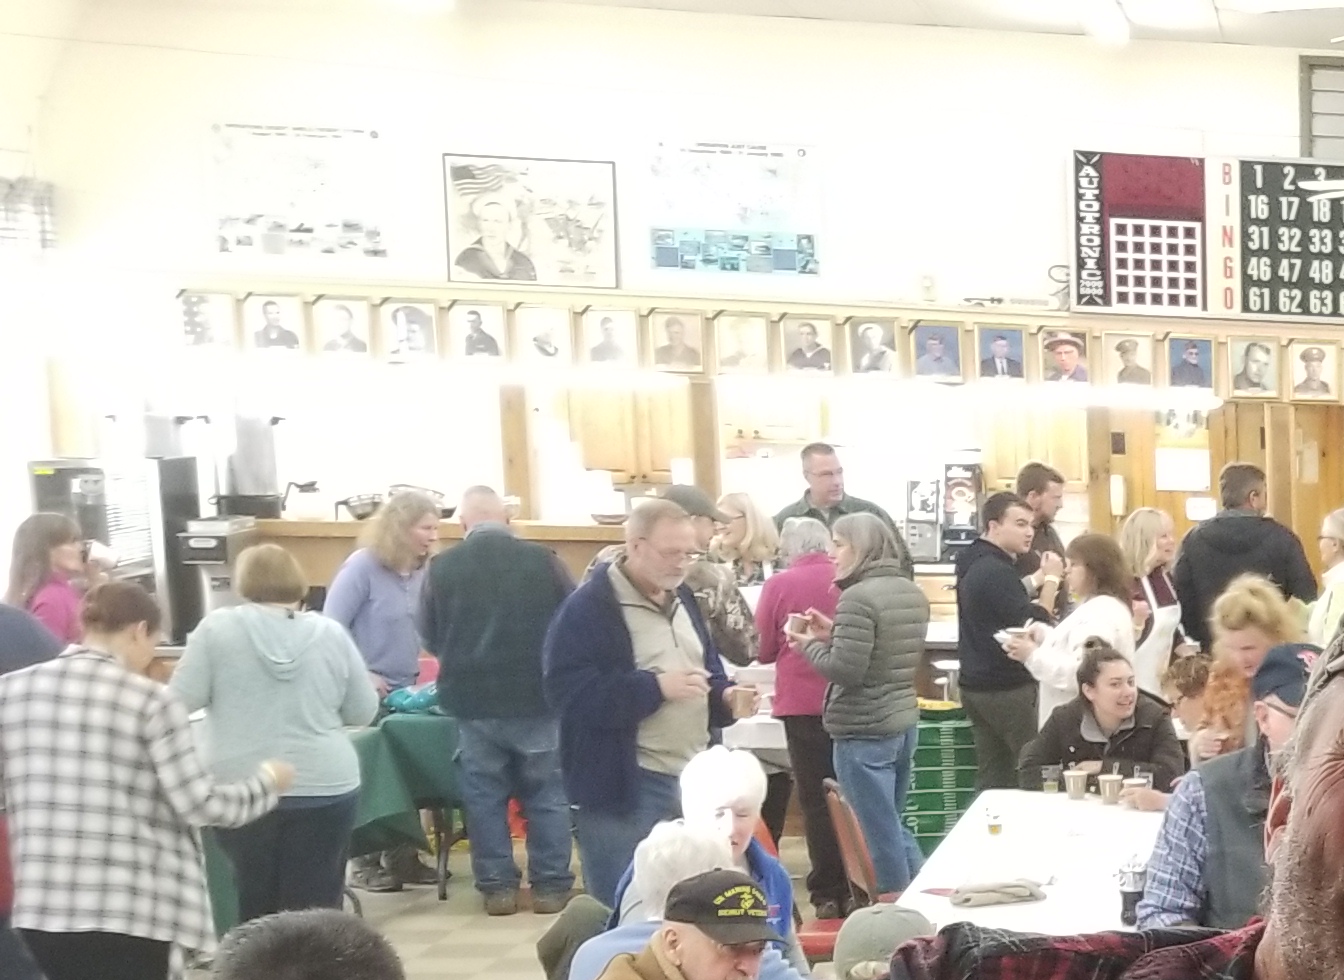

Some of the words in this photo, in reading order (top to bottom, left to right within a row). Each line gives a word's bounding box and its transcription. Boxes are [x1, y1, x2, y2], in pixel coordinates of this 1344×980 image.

[1253, 165, 1263, 188] 1
[1283, 166, 1296, 190] 2
[1248, 195, 1268, 219] 16
[1279, 197, 1300, 220] 17
[1312, 198, 1332, 223] 18
[1248, 225, 1269, 250] 31
[1278, 227, 1301, 251] 32
[1309, 229, 1332, 253] 33
[1248, 257, 1271, 281] 46
[1278, 259, 1301, 282] 47
[1309, 260, 1333, 284] 48
[1249, 287, 1269, 311] 61
[1279, 289, 1302, 312] 62
[1310, 290, 1332, 314] 63
